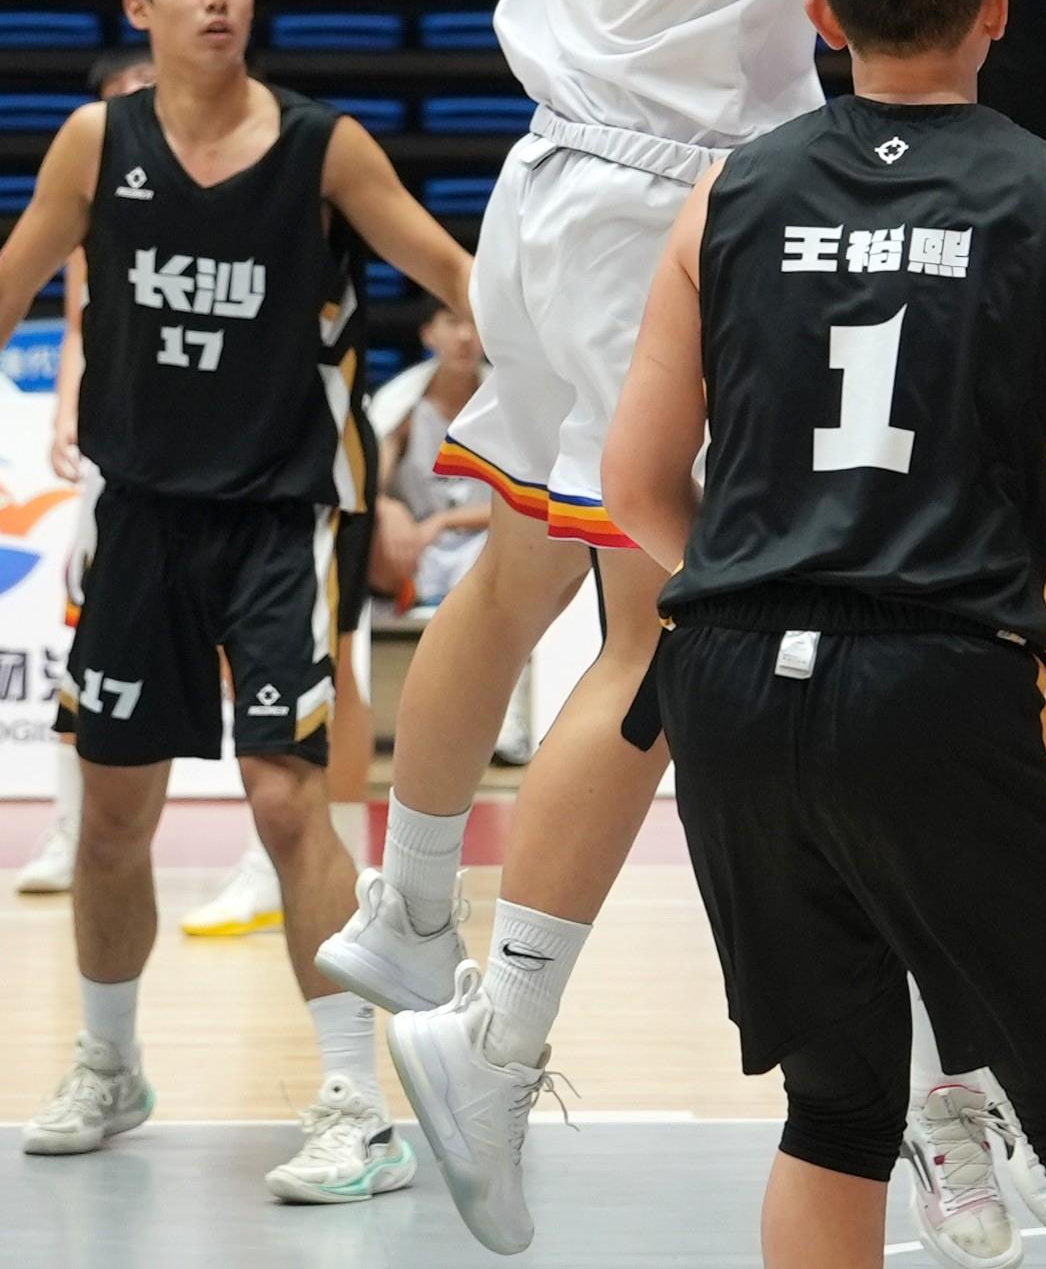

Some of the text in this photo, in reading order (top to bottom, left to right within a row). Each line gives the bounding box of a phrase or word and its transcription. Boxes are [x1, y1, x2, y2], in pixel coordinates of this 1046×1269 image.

[781, 223, 973, 278] 王裕熙
[127, 246, 266, 320] 长沙
[156, 325, 225, 371] 17
[812, 303, 915, 475] 1
[80, 668, 143, 720] 17
